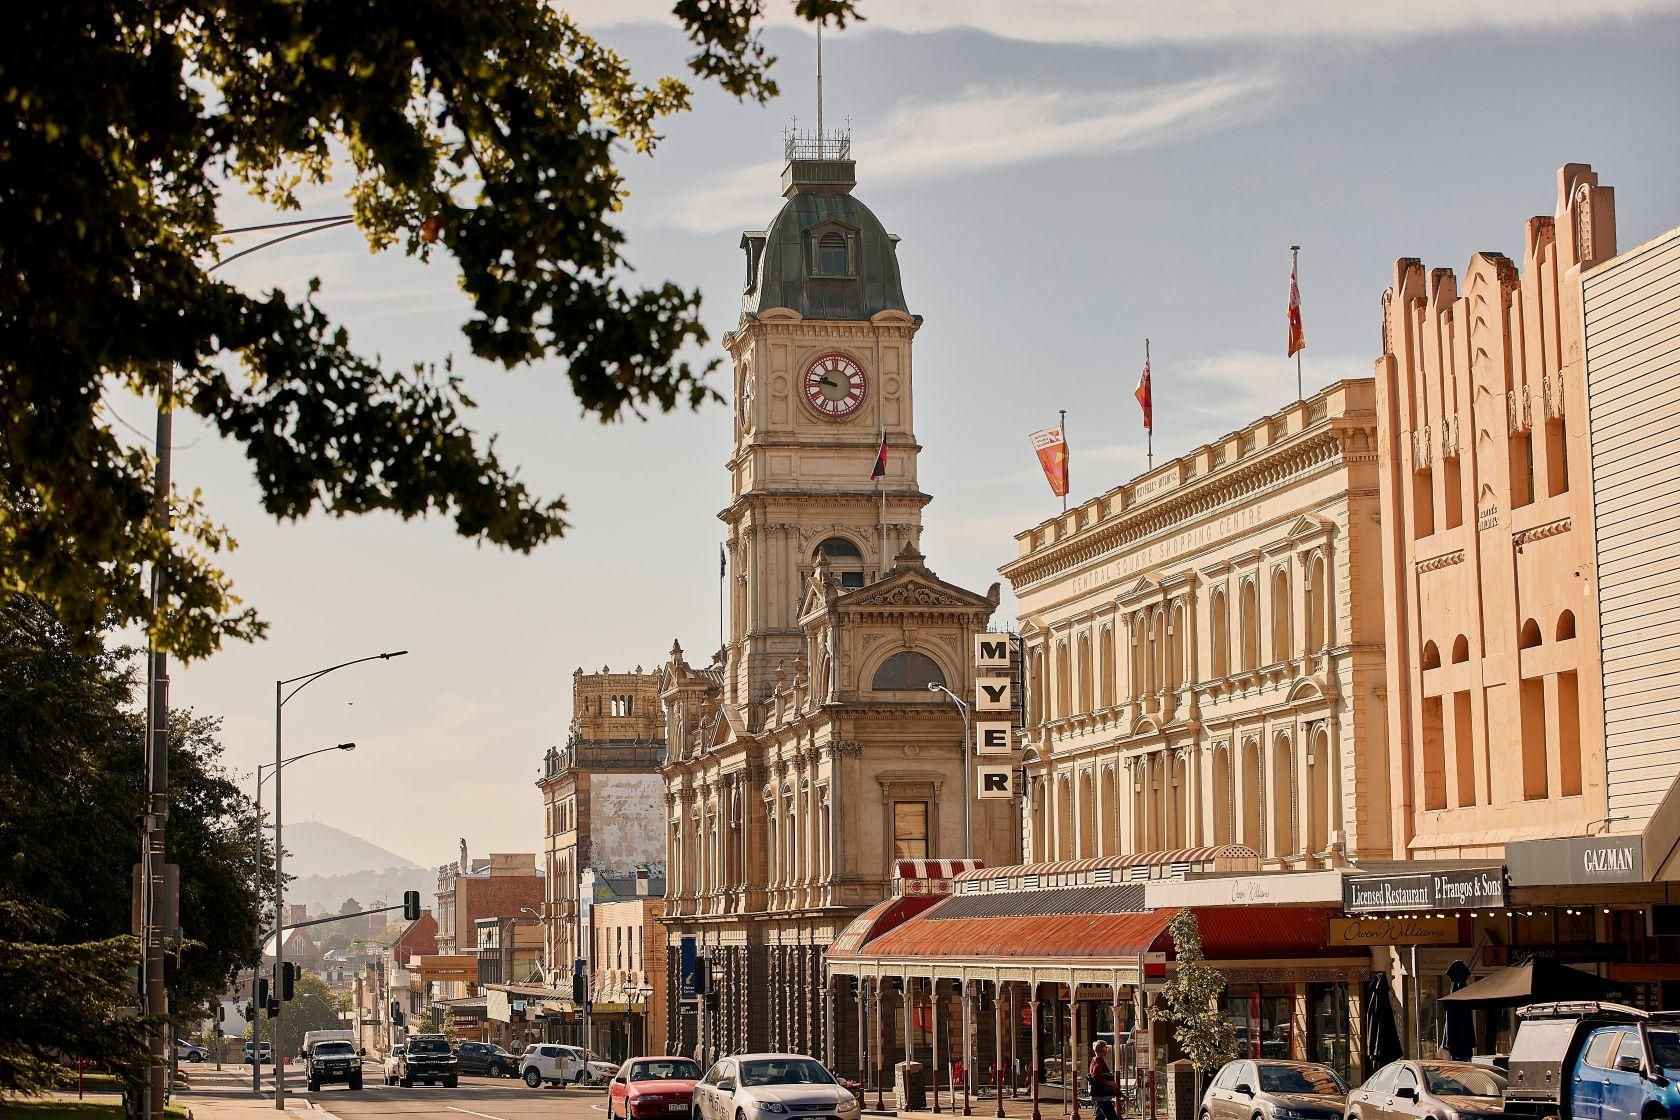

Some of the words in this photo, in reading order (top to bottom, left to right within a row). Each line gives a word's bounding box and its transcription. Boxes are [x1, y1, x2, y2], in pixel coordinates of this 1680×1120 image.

[1072, 565, 1111, 594] CENTRAL
[1116, 547, 1153, 577] SQUARE
[1160, 525, 1212, 559] SHOPPING
[1219, 504, 1262, 537] CENTRE
[980, 641, 1009, 792] MYER
[1583, 847, 1634, 872] GAZMAN
[1351, 882, 1384, 906] Licensed
[1384, 882, 1429, 905] Restaurant
[1441, 876, 1473, 905] Frangos
[1474, 876, 1481, 897] &
[1482, 873, 1502, 896] Sons
[1344, 921, 1380, 941] Owen
[1379, 921, 1445, 940] Williams
[1080, 990, 1104, 999] central
